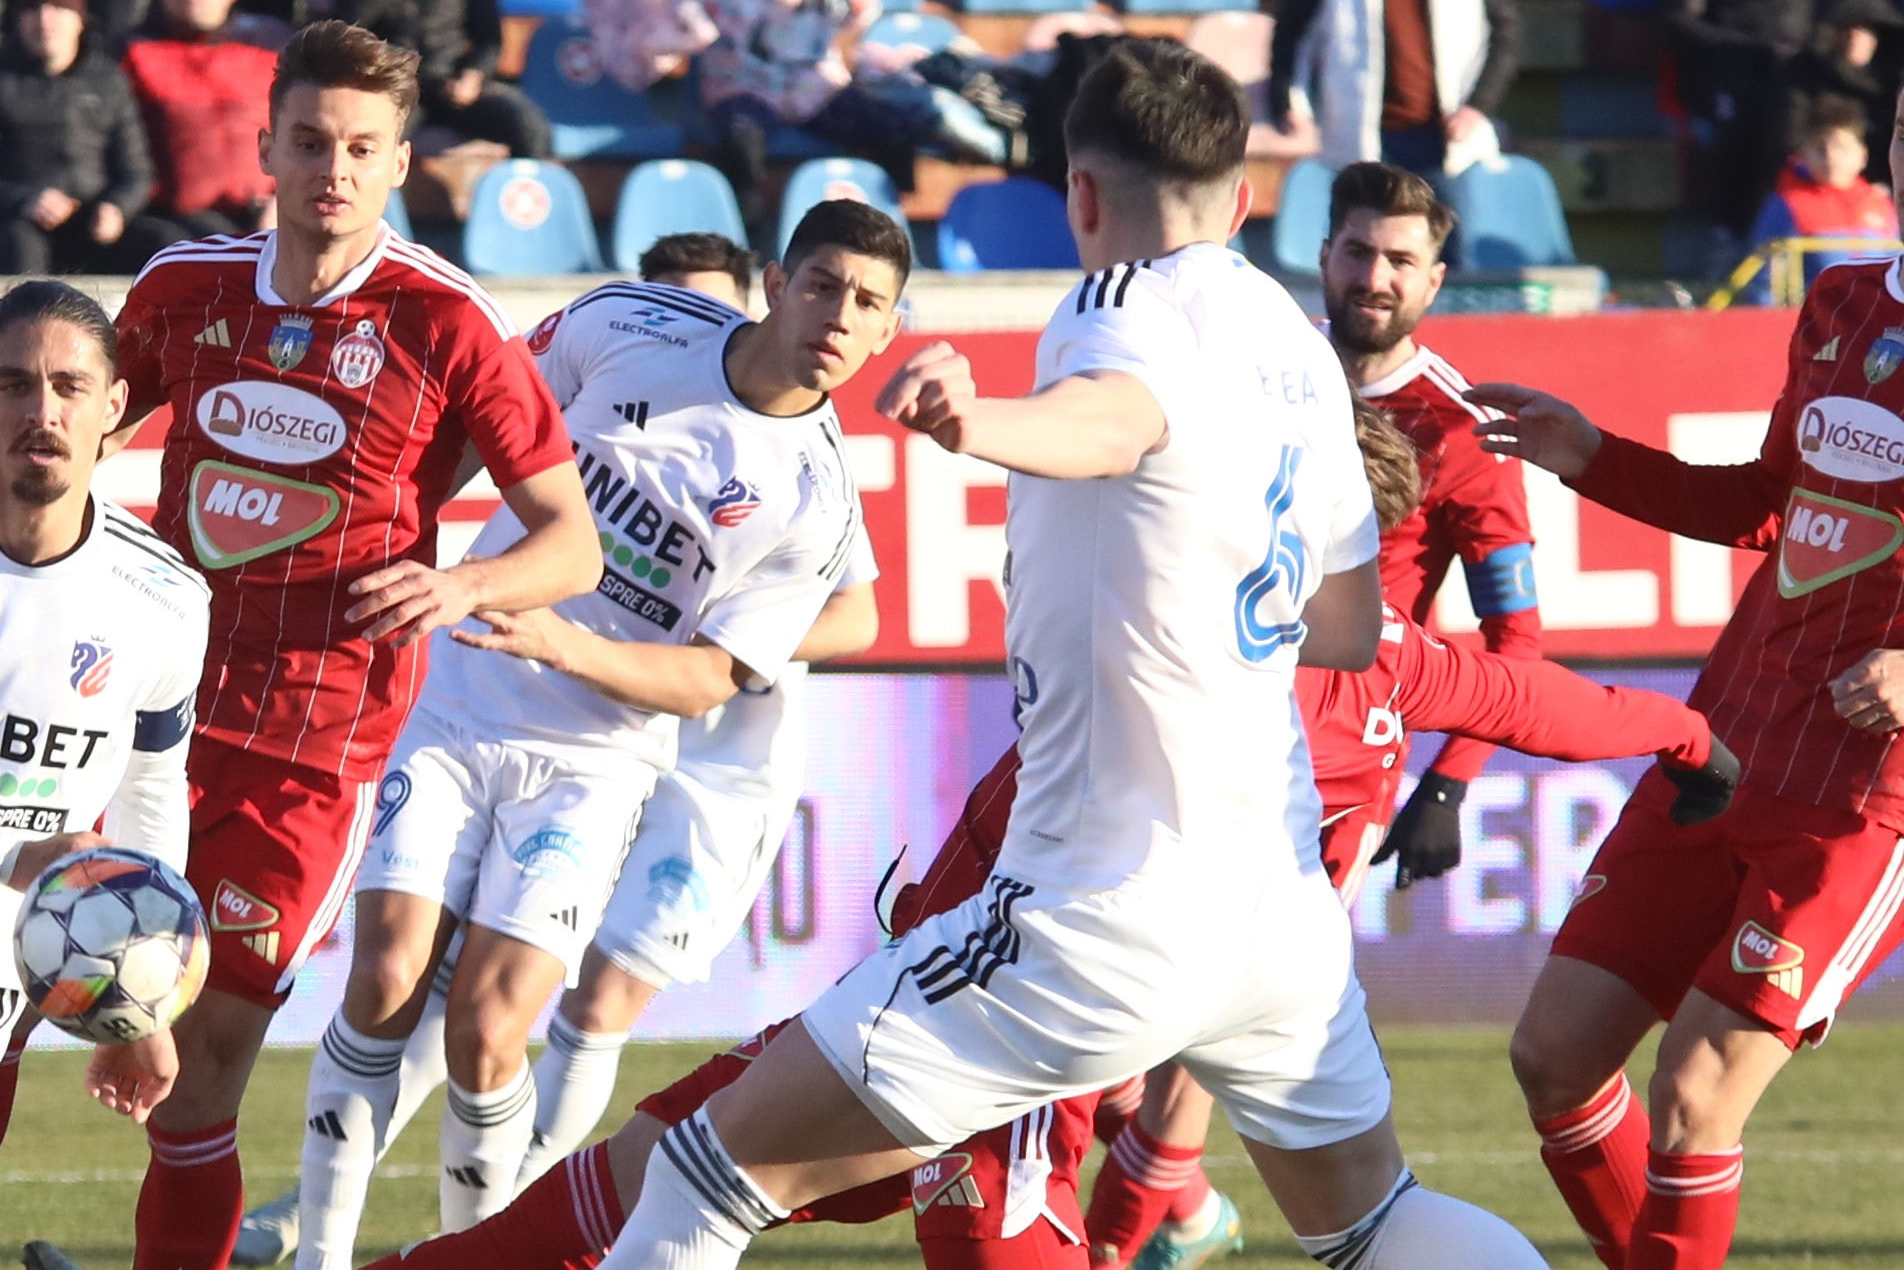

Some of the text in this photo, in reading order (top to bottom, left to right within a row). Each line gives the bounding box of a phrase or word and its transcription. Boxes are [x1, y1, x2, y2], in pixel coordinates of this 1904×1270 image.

[609, 320, 688, 348] ELECTROALFA
[208, 390, 337, 445] DIÓSZEGI
[204, 479, 283, 526] MOL
[1787, 506, 1849, 552] MOL
[599, 574, 669, 625] SPRE 0%
[33, 811, 62, 833] 0%
[219, 888, 253, 919] MOL
[1742, 930, 1779, 960] MOL
[913, 1162, 942, 1189] MOL
